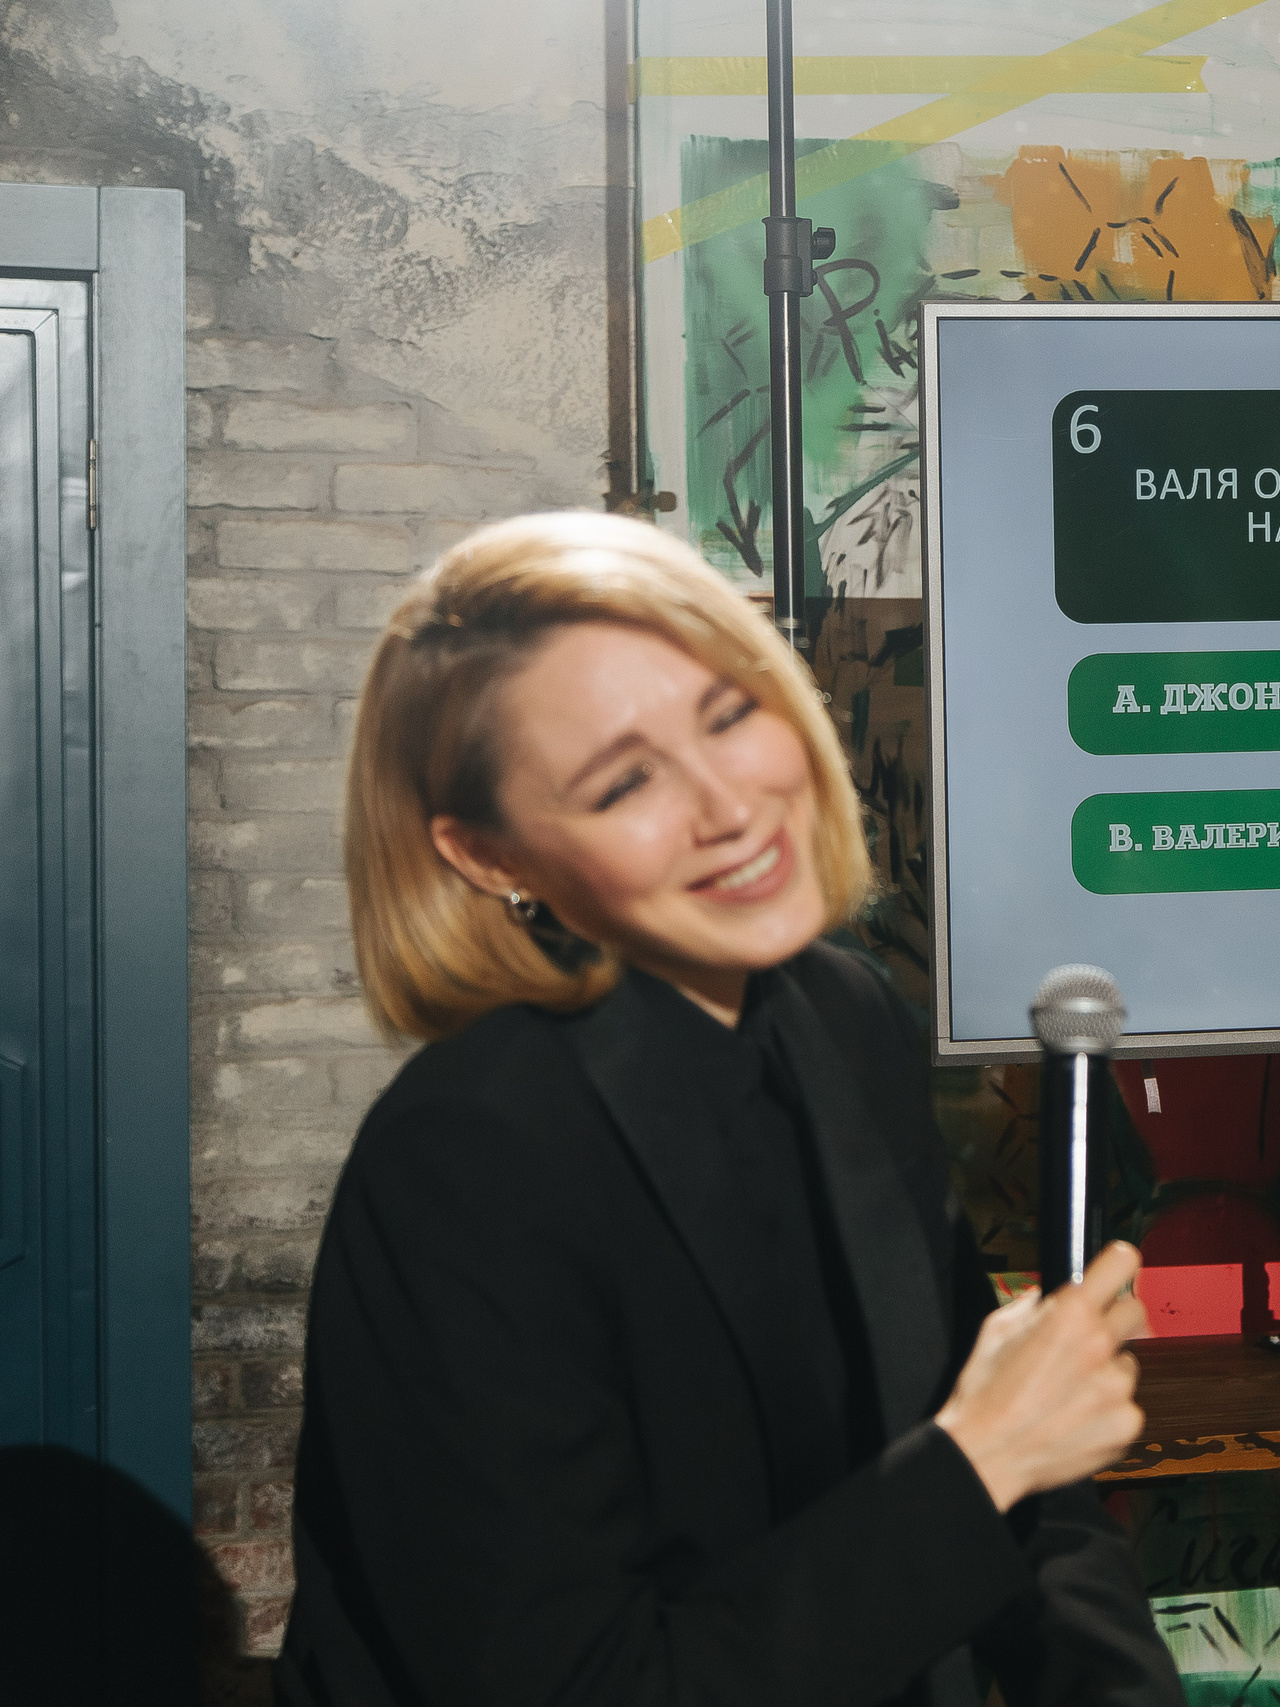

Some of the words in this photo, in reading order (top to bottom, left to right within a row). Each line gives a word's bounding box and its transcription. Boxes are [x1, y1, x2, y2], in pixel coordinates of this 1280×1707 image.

[1070, 404, 1102, 454] 6
[1135, 468, 1238, 500] ВАЛЯ
[1112, 684, 1151, 714] А.
[1108, 823, 1143, 852] В.
